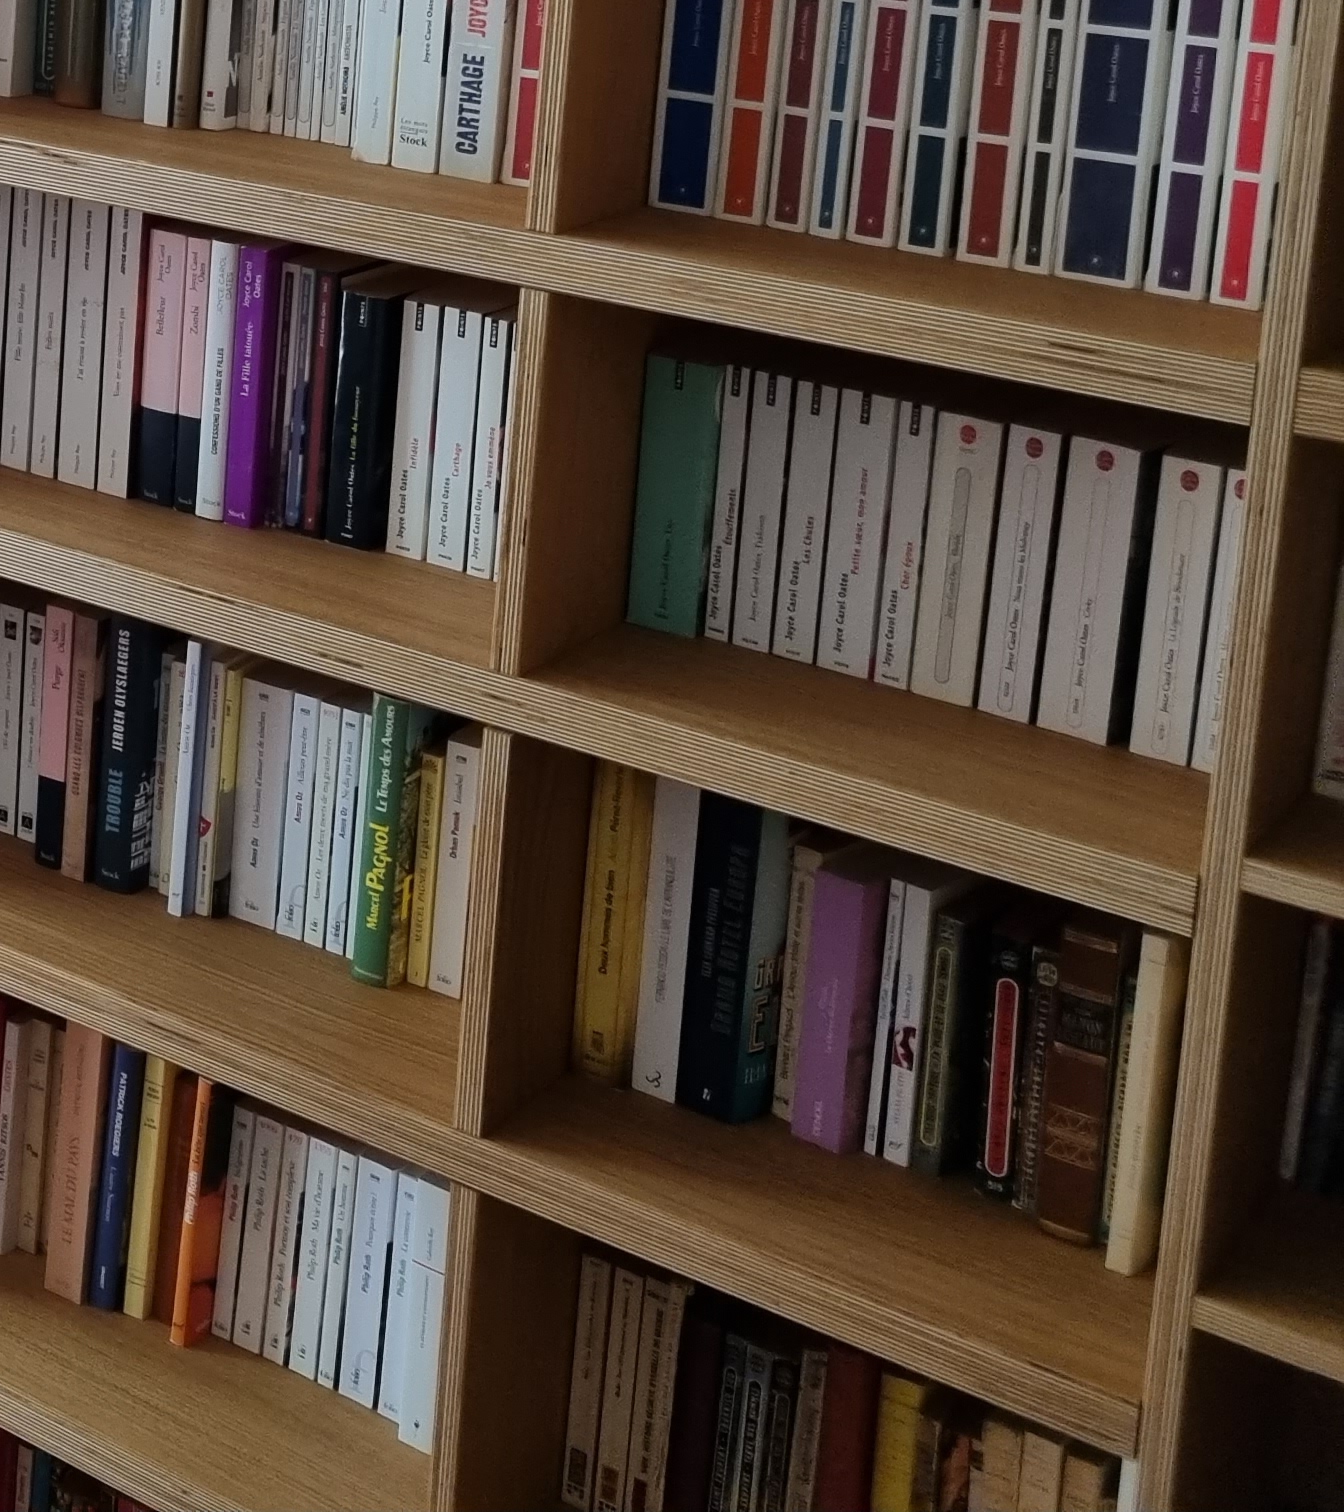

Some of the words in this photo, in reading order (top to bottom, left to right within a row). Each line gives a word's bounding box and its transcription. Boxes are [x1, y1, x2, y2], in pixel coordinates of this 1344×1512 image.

[424, 19, 433, 41] Carol
[422, 43, 432, 63] Joyce
[455, 54, 485, 155] CARTHAGE
[399, 134, 427, 147] Stock
[190, 251, 199, 272] Carol
[217, 256, 227, 287] CAROL
[243, 261, 253, 286] Carol
[189, 273, 199, 292] Joyce
[225, 272, 233, 300] OATES
[252, 274, 262, 299] Oates
[216, 290, 225, 315] JOYCE
[242, 288, 253, 308] Joyce
[189, 305, 200, 335] Zombi
[243, 321, 254, 357] tatouée
[240, 359, 251, 381] Fille
[239, 384, 249, 396] La
[408, 437, 419, 469] Infidèle
[451, 442, 462, 477] Carthage
[399, 469, 408, 490] Oates
[441, 477, 451, 499] Oates
[858, 467, 868, 497] amour
[397, 492, 407, 514] Carol
[439, 501, 450, 522] Carol
[474, 489, 483, 511] Oates
[856, 499, 865, 518] mon
[396, 516, 407, 539] Joyce
[472, 512, 482, 534] Carol
[723, 488, 736, 546] Étouffements
[437, 524, 449, 548] Joyce
[804, 516, 815, 546] Chutes
[470, 536, 481, 560] Joyce
[713, 545, 723, 569] Oates
[801, 548, 812, 564] Les
[902, 542, 913, 568] époux
[790, 560, 801, 586] Oates
[850, 549, 861, 575] Petite
[711, 571, 721, 594] Carol
[838, 573, 849, 598] Oates
[900, 571, 910, 590] Cher
[709, 596, 719, 620] Joyce
[787, 589, 799, 613] Carol
[836, 600, 847, 624] Carol
[887, 590, 898, 614] Oates
[784, 616, 797, 641] Joyce
[833, 628, 845, 653] Joyce
[884, 617, 896, 640] Carol
[882, 643, 894, 667] Joyce
[51, 665, 61, 690] Purge
[114, 629, 130, 707] OLYSLAEGERS
[112, 710, 125, 752] JEROEN
[105, 769, 123, 833] TROUBLE
[67, 1137, 80, 1167] PAYS
[258, 1147, 270, 1167] tache
[65, 1169, 78, 1193] DU
[256, 1169, 267, 1181] La
[255, 1186, 266, 1205] Roth
[63, 1195, 76, 1224] MAL
[252, 1206, 267, 1231] Philip
[62, 1227, 73, 1244] LE
